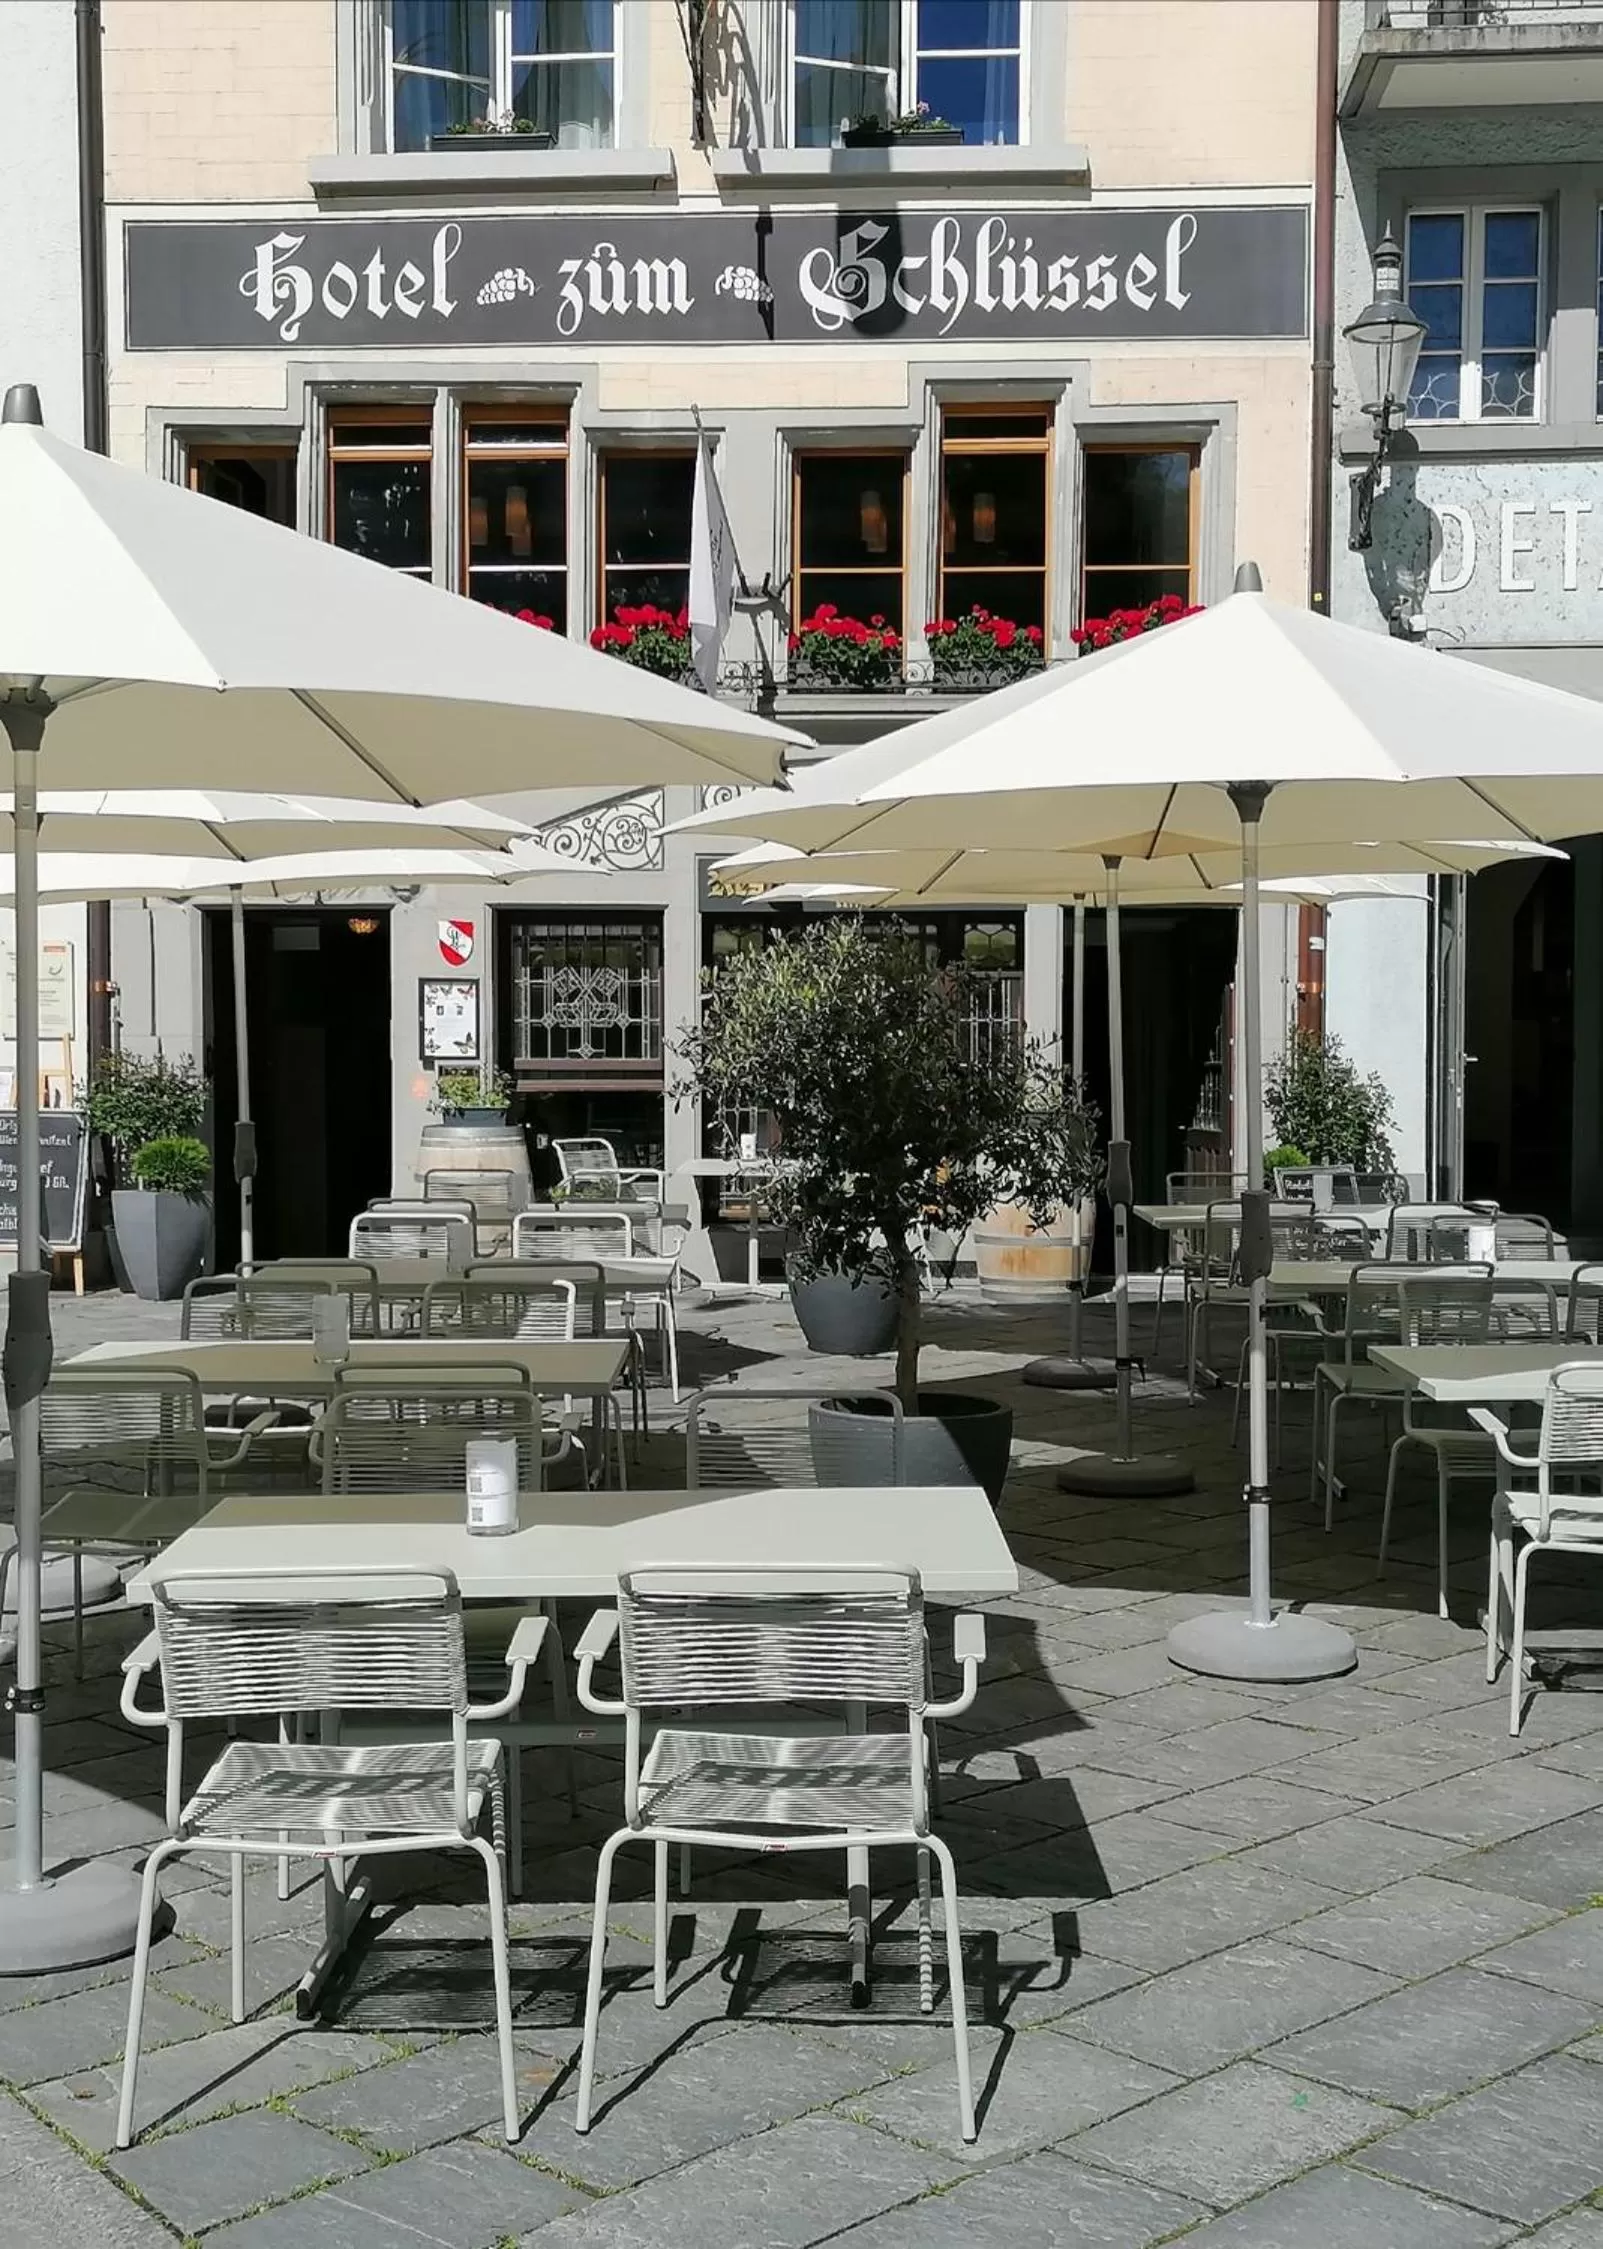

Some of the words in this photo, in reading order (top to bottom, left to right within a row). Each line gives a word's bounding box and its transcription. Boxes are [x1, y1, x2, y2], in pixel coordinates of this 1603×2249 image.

[239, 223, 463, 342] Hotel
[799, 213, 1199, 335] Schlüssel
[1427, 500, 1603, 594] DET
